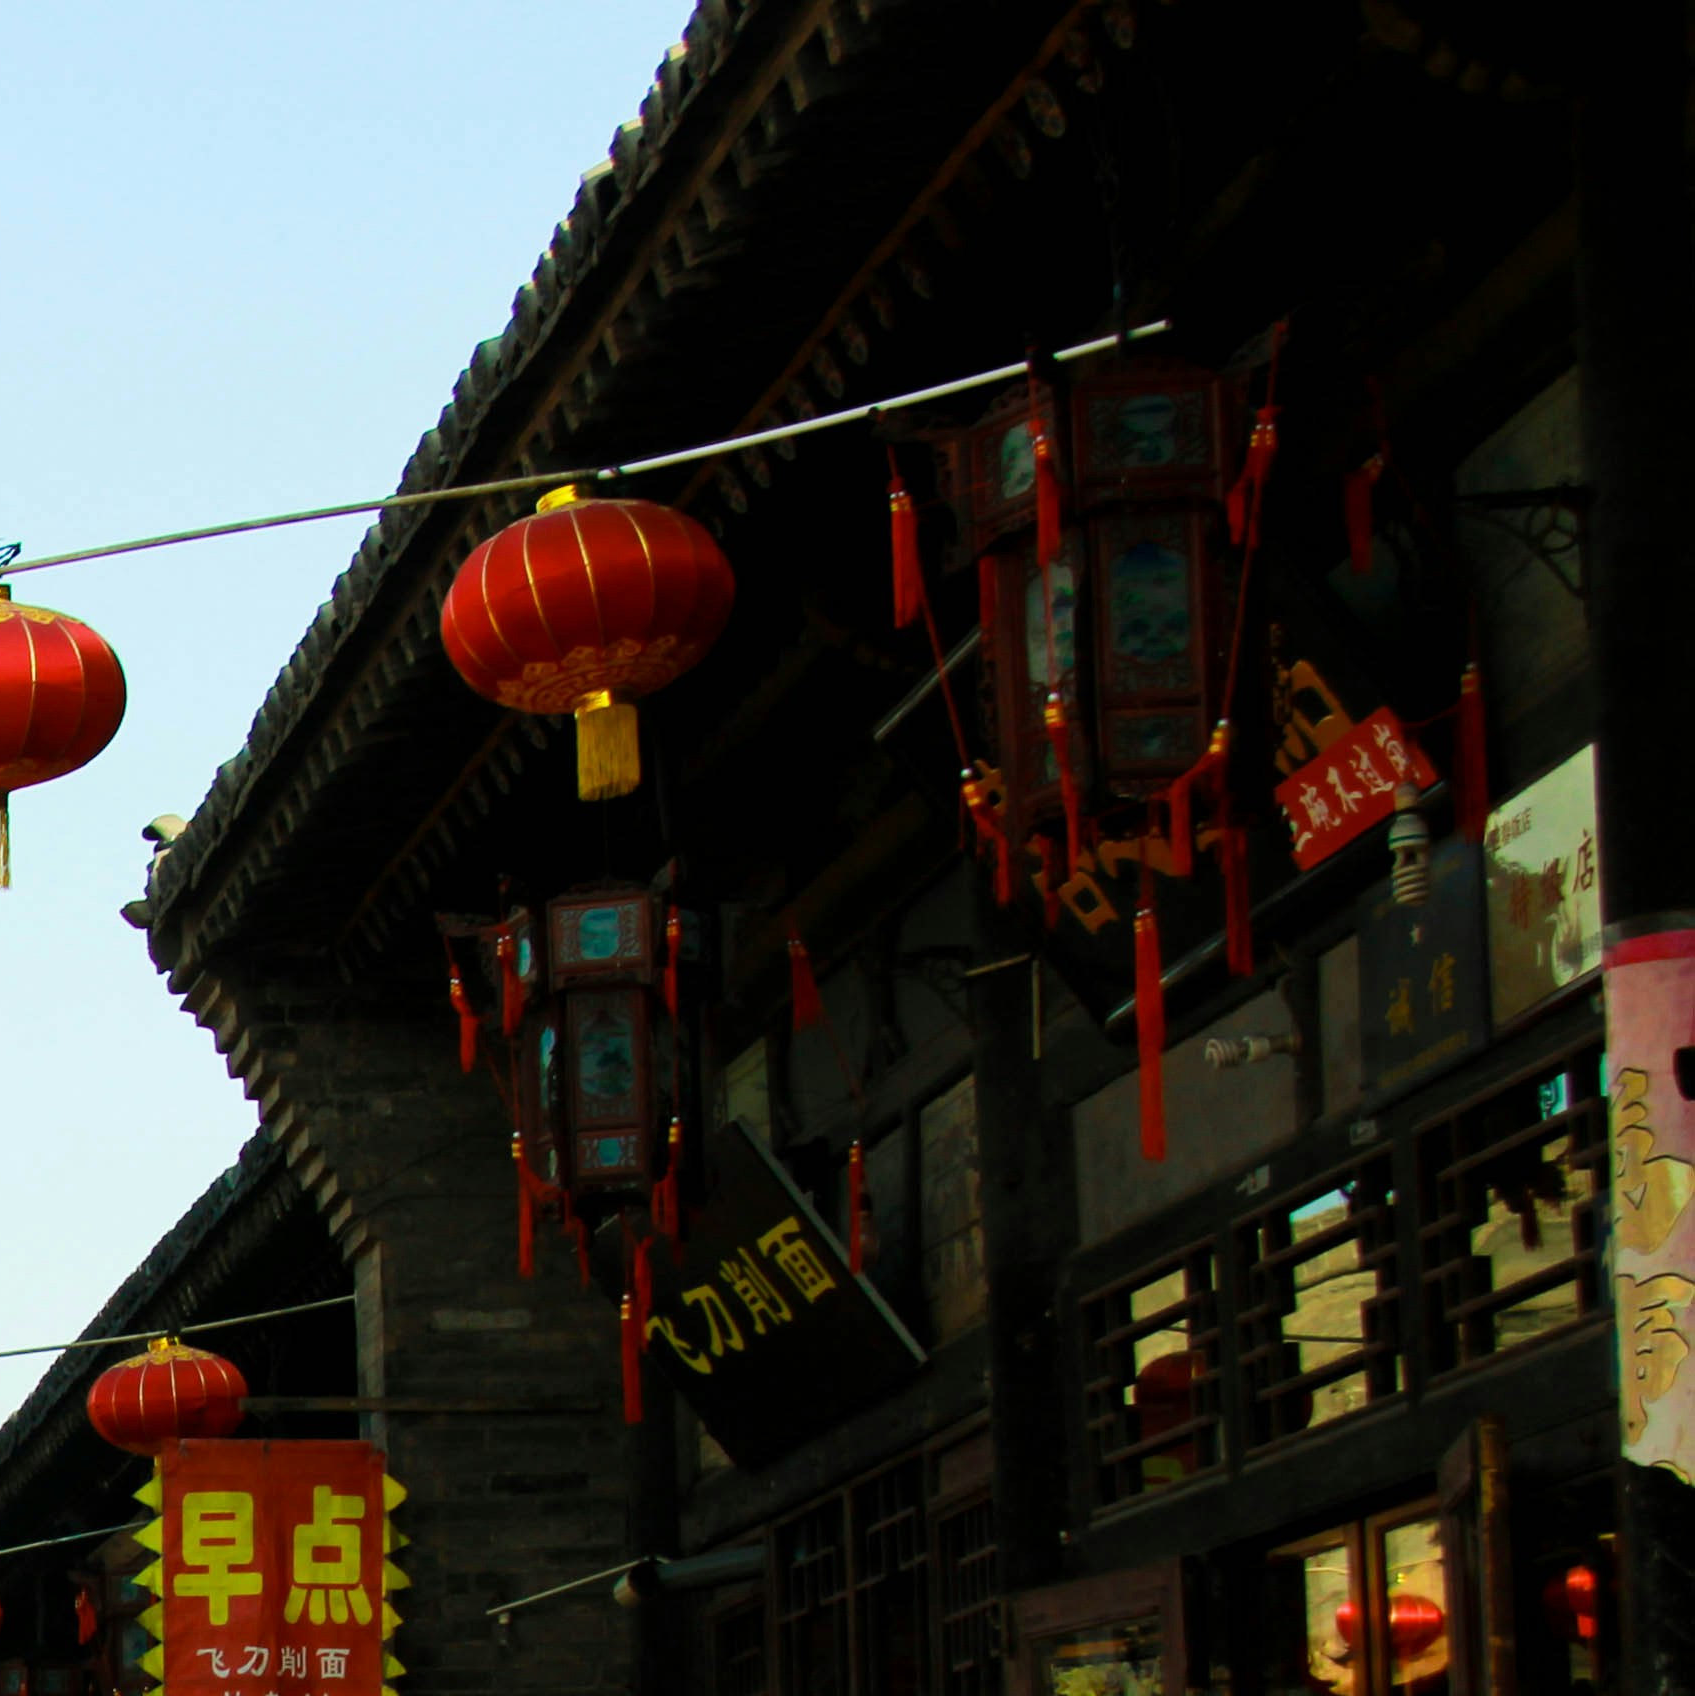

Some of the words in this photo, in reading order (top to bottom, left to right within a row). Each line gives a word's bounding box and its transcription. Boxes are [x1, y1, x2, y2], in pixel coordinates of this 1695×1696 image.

[645, 1215, 837, 1375] 飞刀削面
[173, 1485, 372, 1625] 早点
[196, 1646, 350, 1679] 飞刀削面
